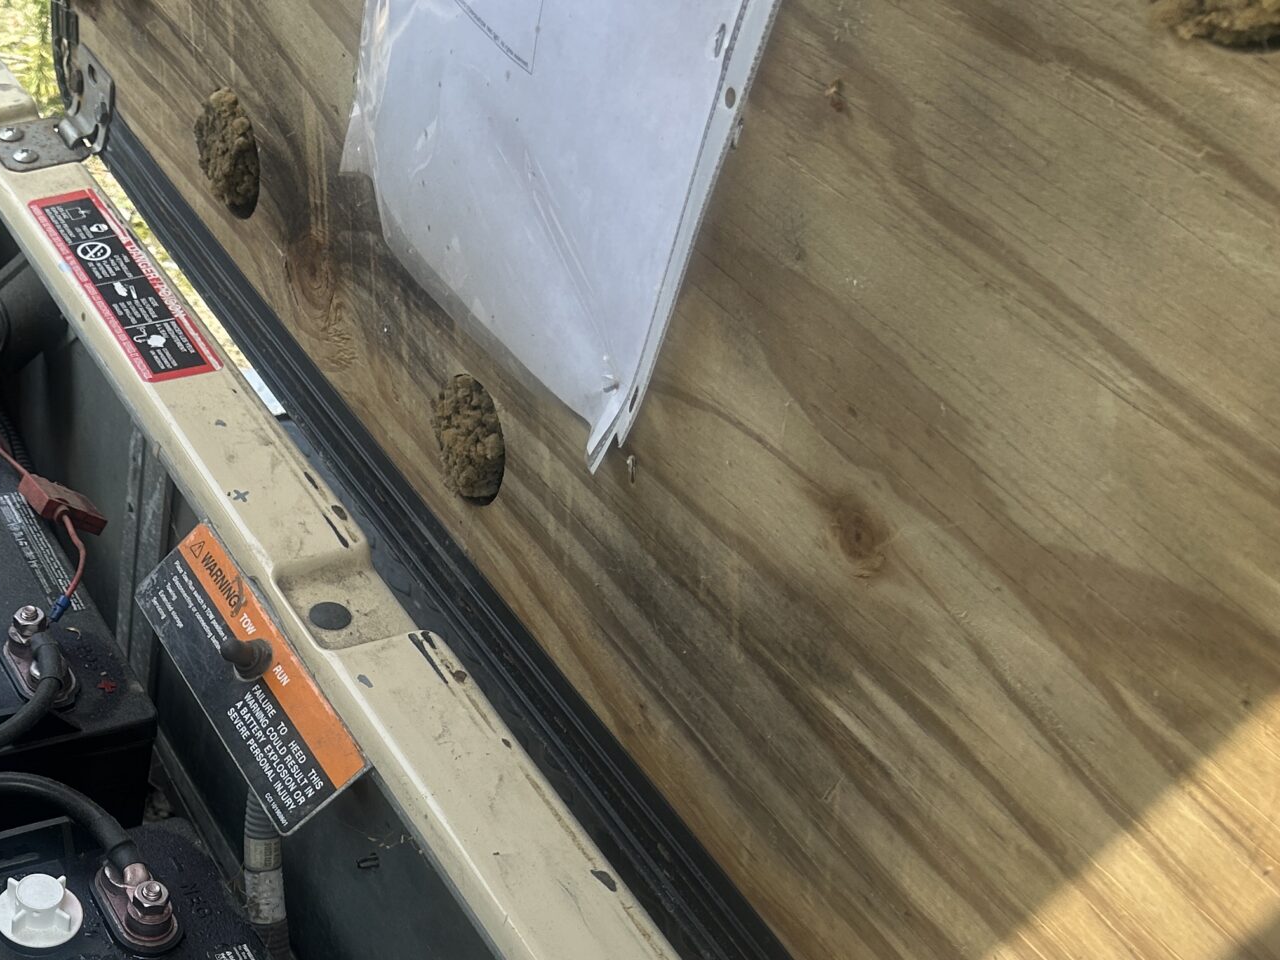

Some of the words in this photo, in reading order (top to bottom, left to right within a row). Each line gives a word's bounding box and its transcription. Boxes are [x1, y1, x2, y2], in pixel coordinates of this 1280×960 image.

[125, 244, 160, 280] DANGER
[199, 551, 241, 609] WARNING
[204, 606, 215, 621] TOW
[237, 611, 257, 636] TOW
[271, 662, 291, 687] RUN
[234, 698, 244, 710] A
[238, 705, 267, 745] BATTERY
[242, 690, 270, 729] WARNING
[264, 725, 288, 756] COULD
[282, 753, 308, 788] RESULT
[302, 785, 315, 798] IN
[250, 683, 277, 719] FAILURE
[274, 720, 289, 737] TO
[286, 738, 308, 766] HEED
[305, 767, 324, 791] THIS
[225, 706, 251, 740] SEVERE
[245, 737, 278, 783] PERSONAL
[271, 779, 297, 814] INJURY.
[262, 743, 297, 792] EXPLOSION
[291, 788, 306, 806] OR
